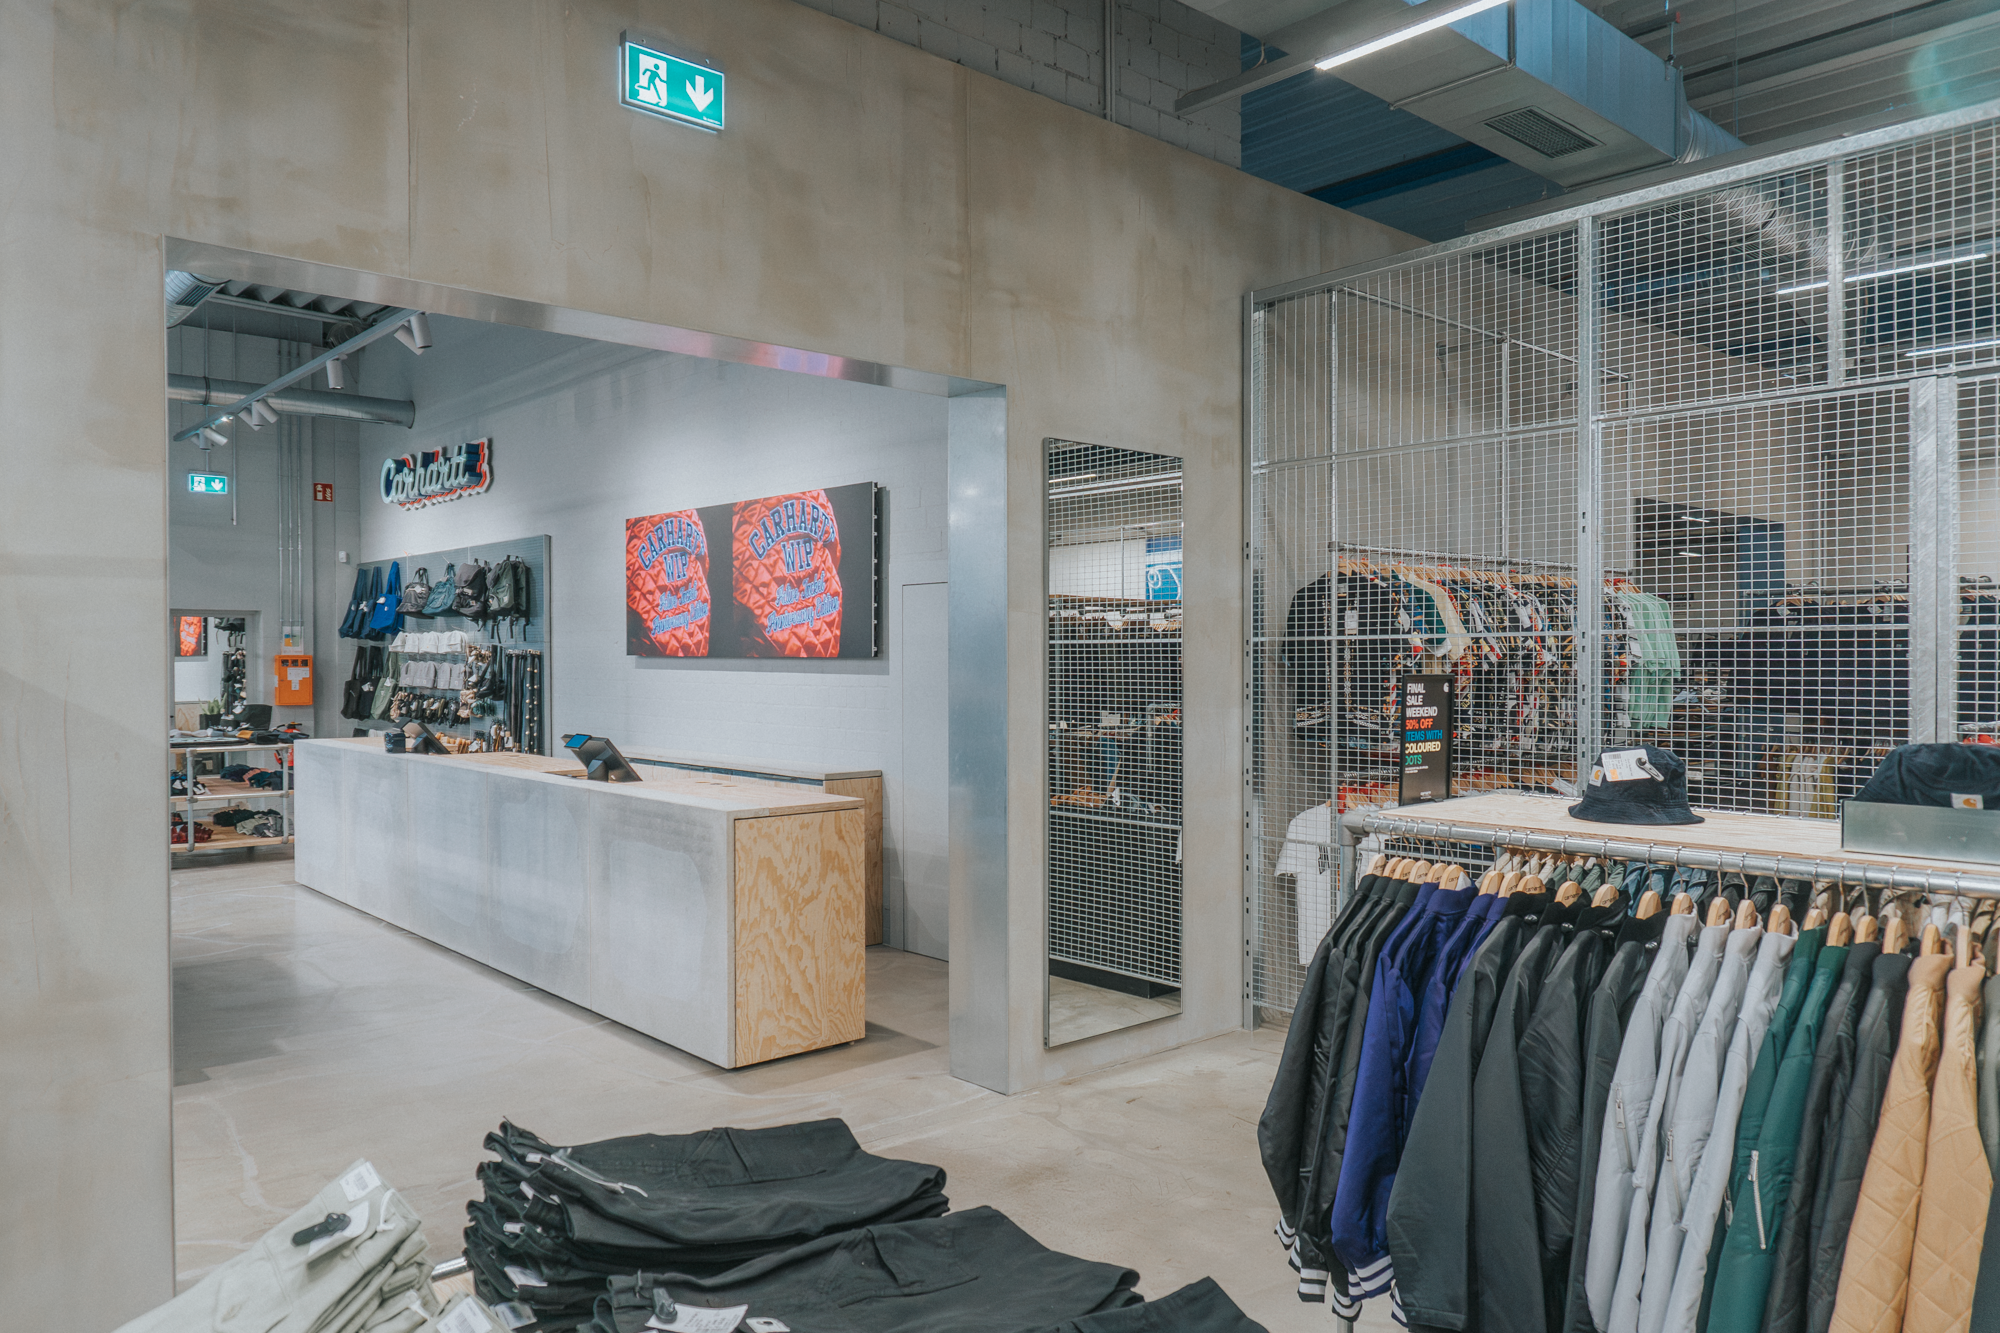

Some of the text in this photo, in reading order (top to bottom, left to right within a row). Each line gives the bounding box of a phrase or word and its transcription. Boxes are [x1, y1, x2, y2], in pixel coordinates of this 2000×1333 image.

[381, 442, 472, 504] Carhartt
[781, 538, 814, 574] WIP
[663, 552, 689, 583] WIP
[775, 570, 825, 607] Active Jacket
[658, 591, 678, 612] Active
[765, 592, 840, 635] Anniversary Edition
[1406, 683, 1426, 694] FINAL
[1406, 695, 1423, 706] SALE
[1405, 706, 1438, 718] WEEKEND
[1405, 718, 1434, 730] 50% OFF
[1405, 729, 1443, 742] ITEMS WITH
